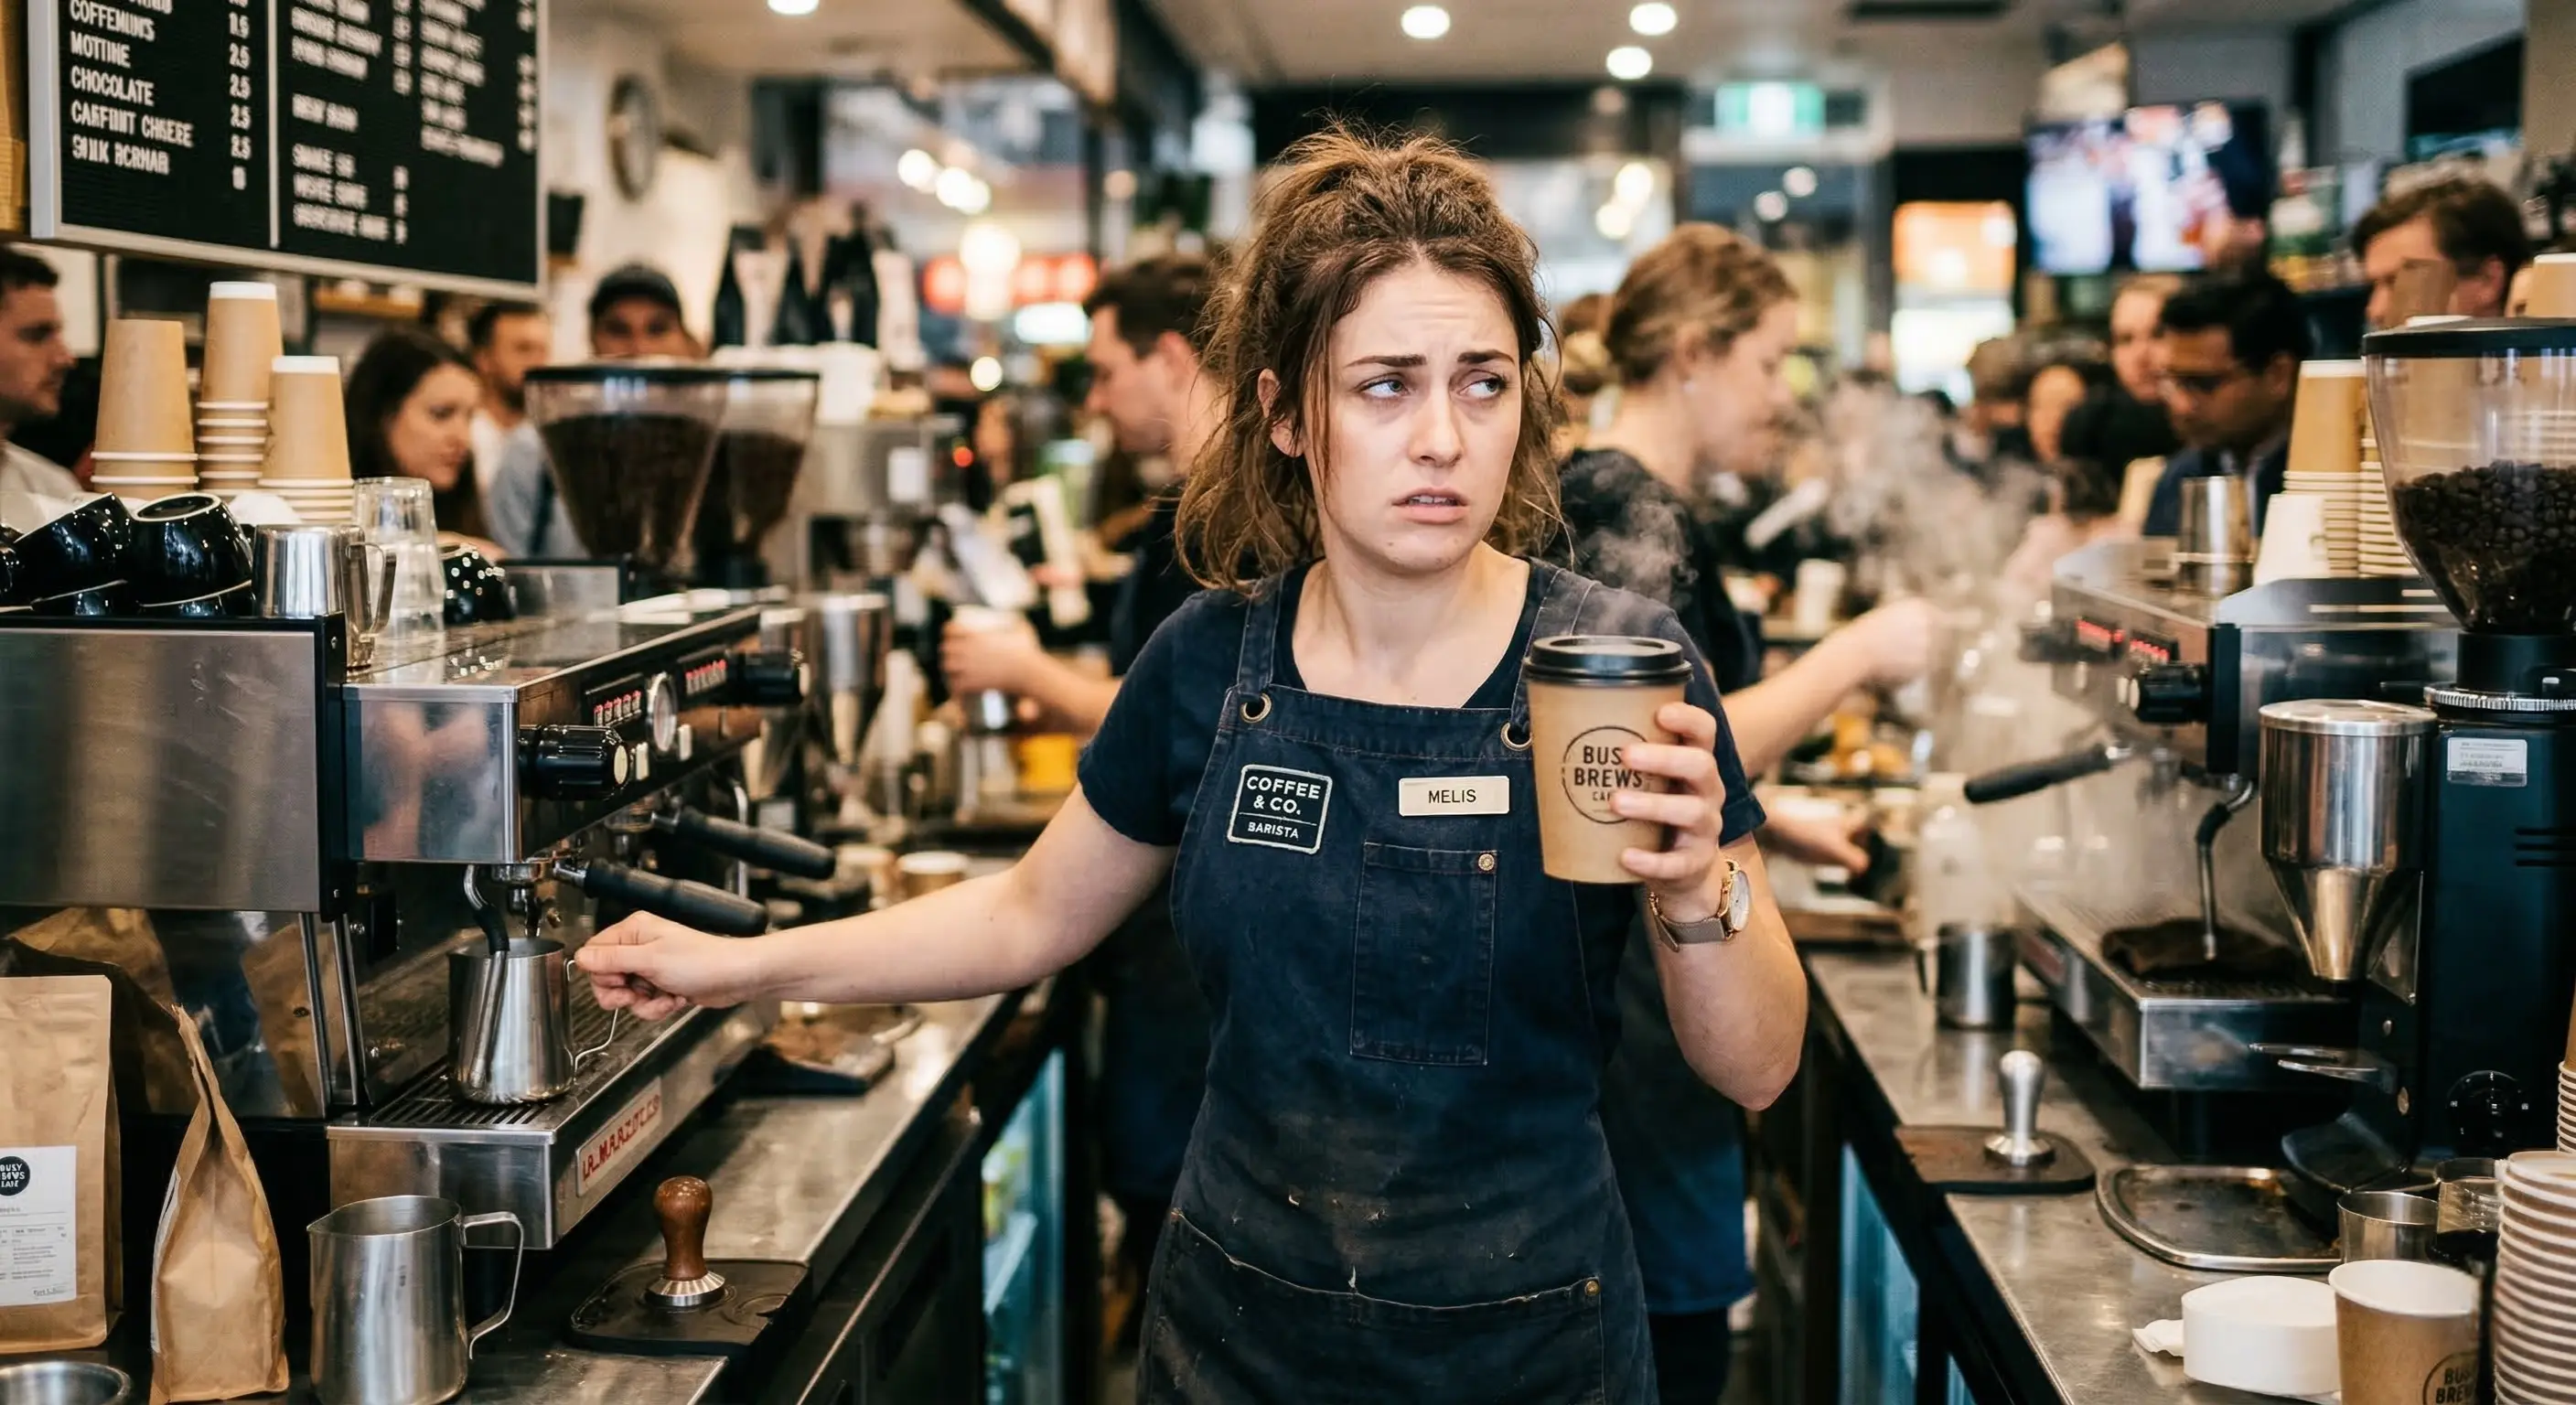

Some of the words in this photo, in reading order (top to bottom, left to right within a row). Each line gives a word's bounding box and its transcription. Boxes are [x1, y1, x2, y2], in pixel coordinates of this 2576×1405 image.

[70, 65, 155, 106] CHOCOLATE
[1583, 745, 1623, 766] BUS
[1247, 776, 1321, 799] COFFEE
[1574, 767, 1643, 788] BREWS
[1253, 794, 1265, 809] &
[1270, 797, 1301, 815] CO.
[1428, 789, 1476, 803] MELIS
[1248, 821, 1299, 839] BARISTA
